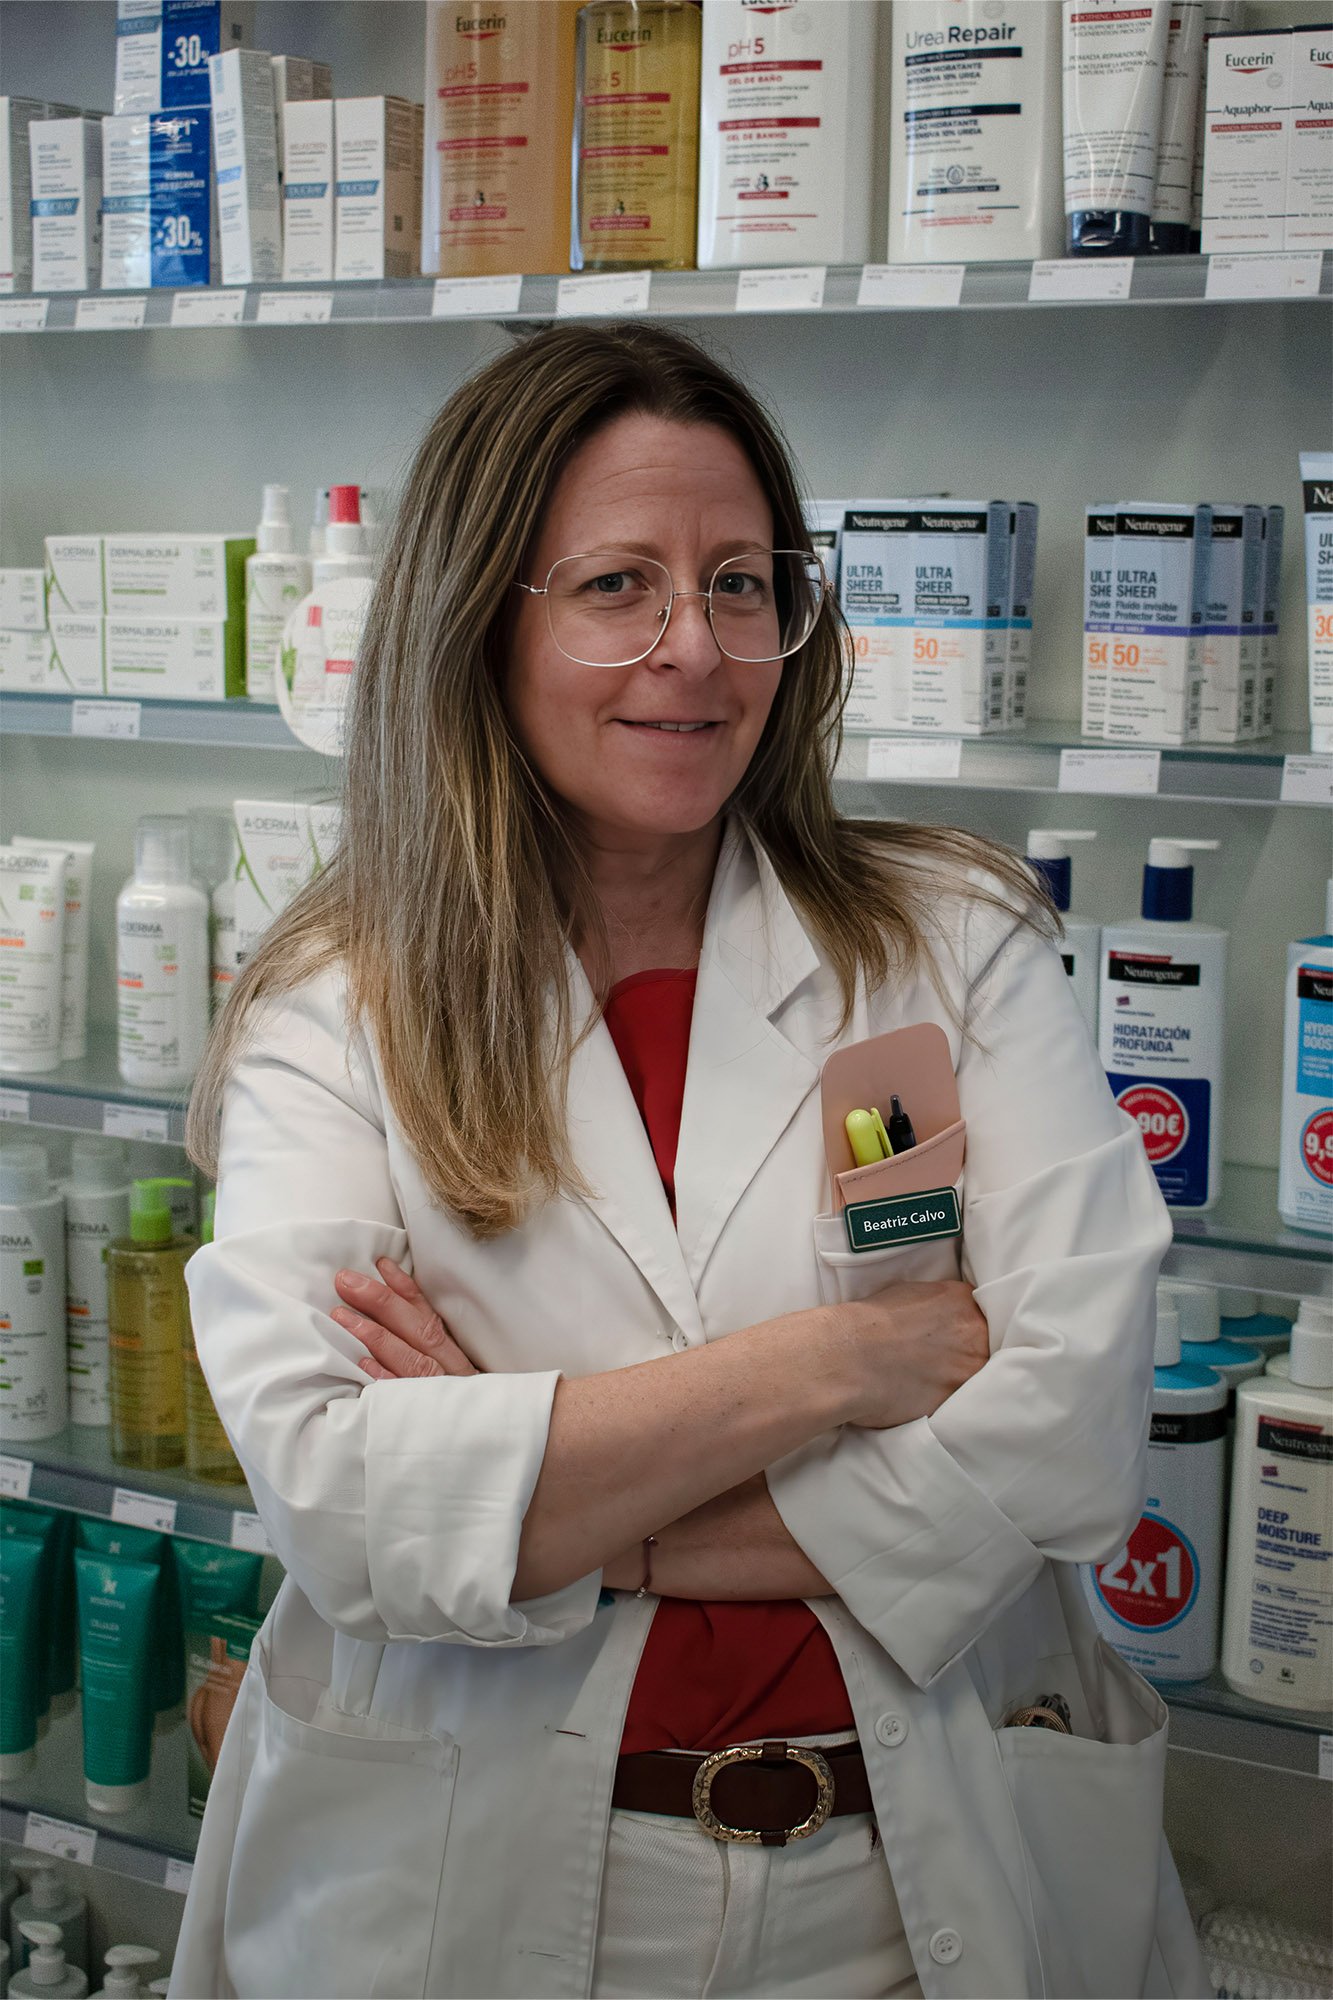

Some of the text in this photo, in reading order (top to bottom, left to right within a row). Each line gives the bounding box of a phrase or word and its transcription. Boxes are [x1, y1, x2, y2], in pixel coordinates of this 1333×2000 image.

[456, 14, 506, 33] Eucerin
[597, 27, 652, 43] Eucerin
[905, 22, 1016, 49] Urea Repair
[1225, 52, 1274, 67] Eucerin
[1223, 103, 1272, 117] Aquaphor
[846, 565, 883, 578] ULTRA
[915, 566, 953, 579] ULTRA
[1117, 571, 1157, 584] ULTRA
[846, 579, 883, 592] SHEER
[915, 581, 953, 593] SHEER
[1116, 585, 1157, 598] SHEER
[846, 605, 902, 614] Protector Solar
[915, 607, 973, 616] Protector Solar
[1115, 601, 1178, 611] Fluido invisible
[1115, 611, 1178, 622] Protector Solar
[913, 637, 939, 660] 50
[1112, 643, 1140, 667] 50
[244, 817, 299, 831] A-DERMA
[1123, 964, 1184, 982] Neutrogena
[1113, 1023, 1191, 1041] HIDRATACIÓN
[1113, 1036, 1174, 1053] PROFUNDA
[864, 1209, 946, 1232] Beatriz Calvo
[1257, 1507, 1289, 1525] DEEP
[1256, 1522, 1322, 1546] MOISTURE
[1100, 1545, 1182, 1600] 2x1
